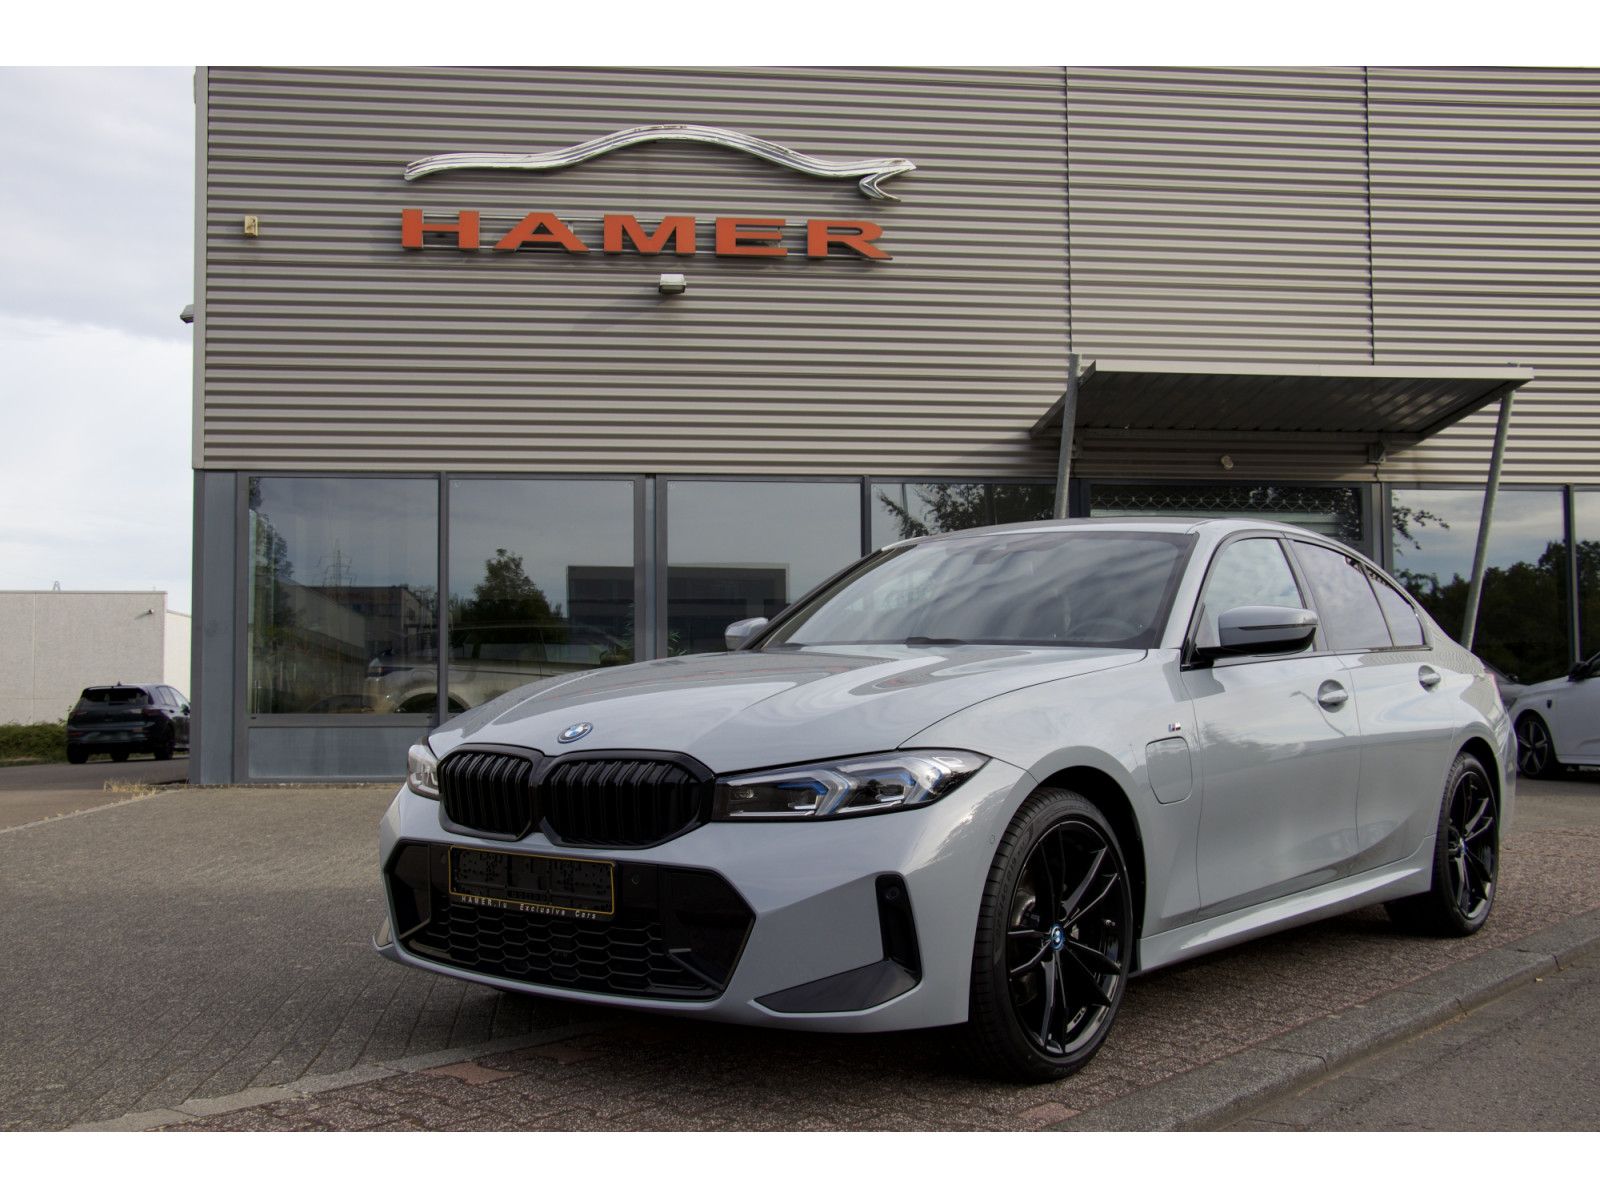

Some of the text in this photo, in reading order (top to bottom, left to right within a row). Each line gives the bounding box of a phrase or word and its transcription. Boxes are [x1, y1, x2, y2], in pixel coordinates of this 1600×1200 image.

[401, 208, 893, 261] HAMER
[519, 903, 566, 916] Exclusive
[575, 910, 597, 920] Cars
